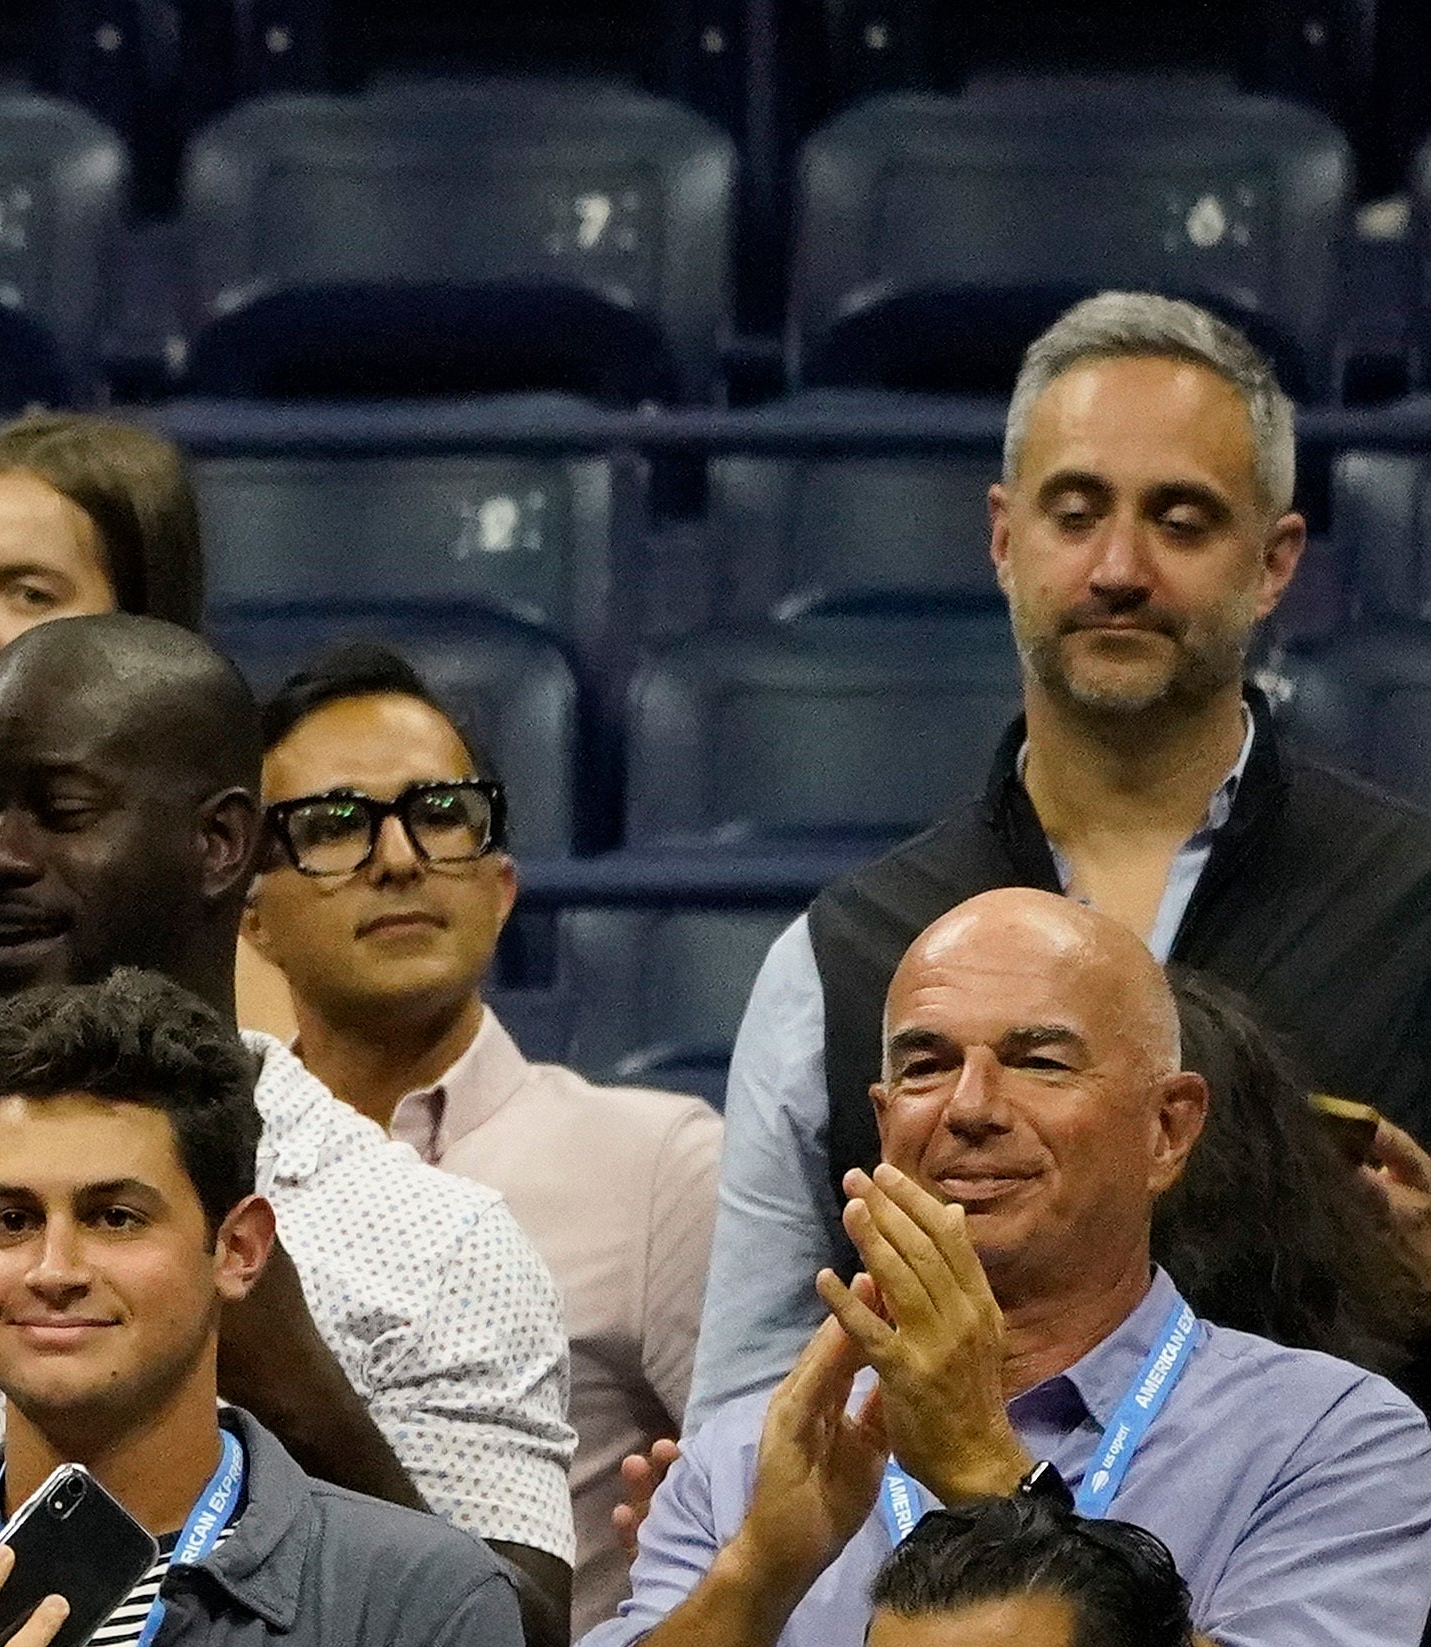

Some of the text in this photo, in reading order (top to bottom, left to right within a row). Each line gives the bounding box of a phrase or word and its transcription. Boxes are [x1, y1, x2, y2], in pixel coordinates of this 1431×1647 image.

[1135, 1322, 1186, 1409] AMERICAN
[1103, 1424, 1131, 1470] us open
